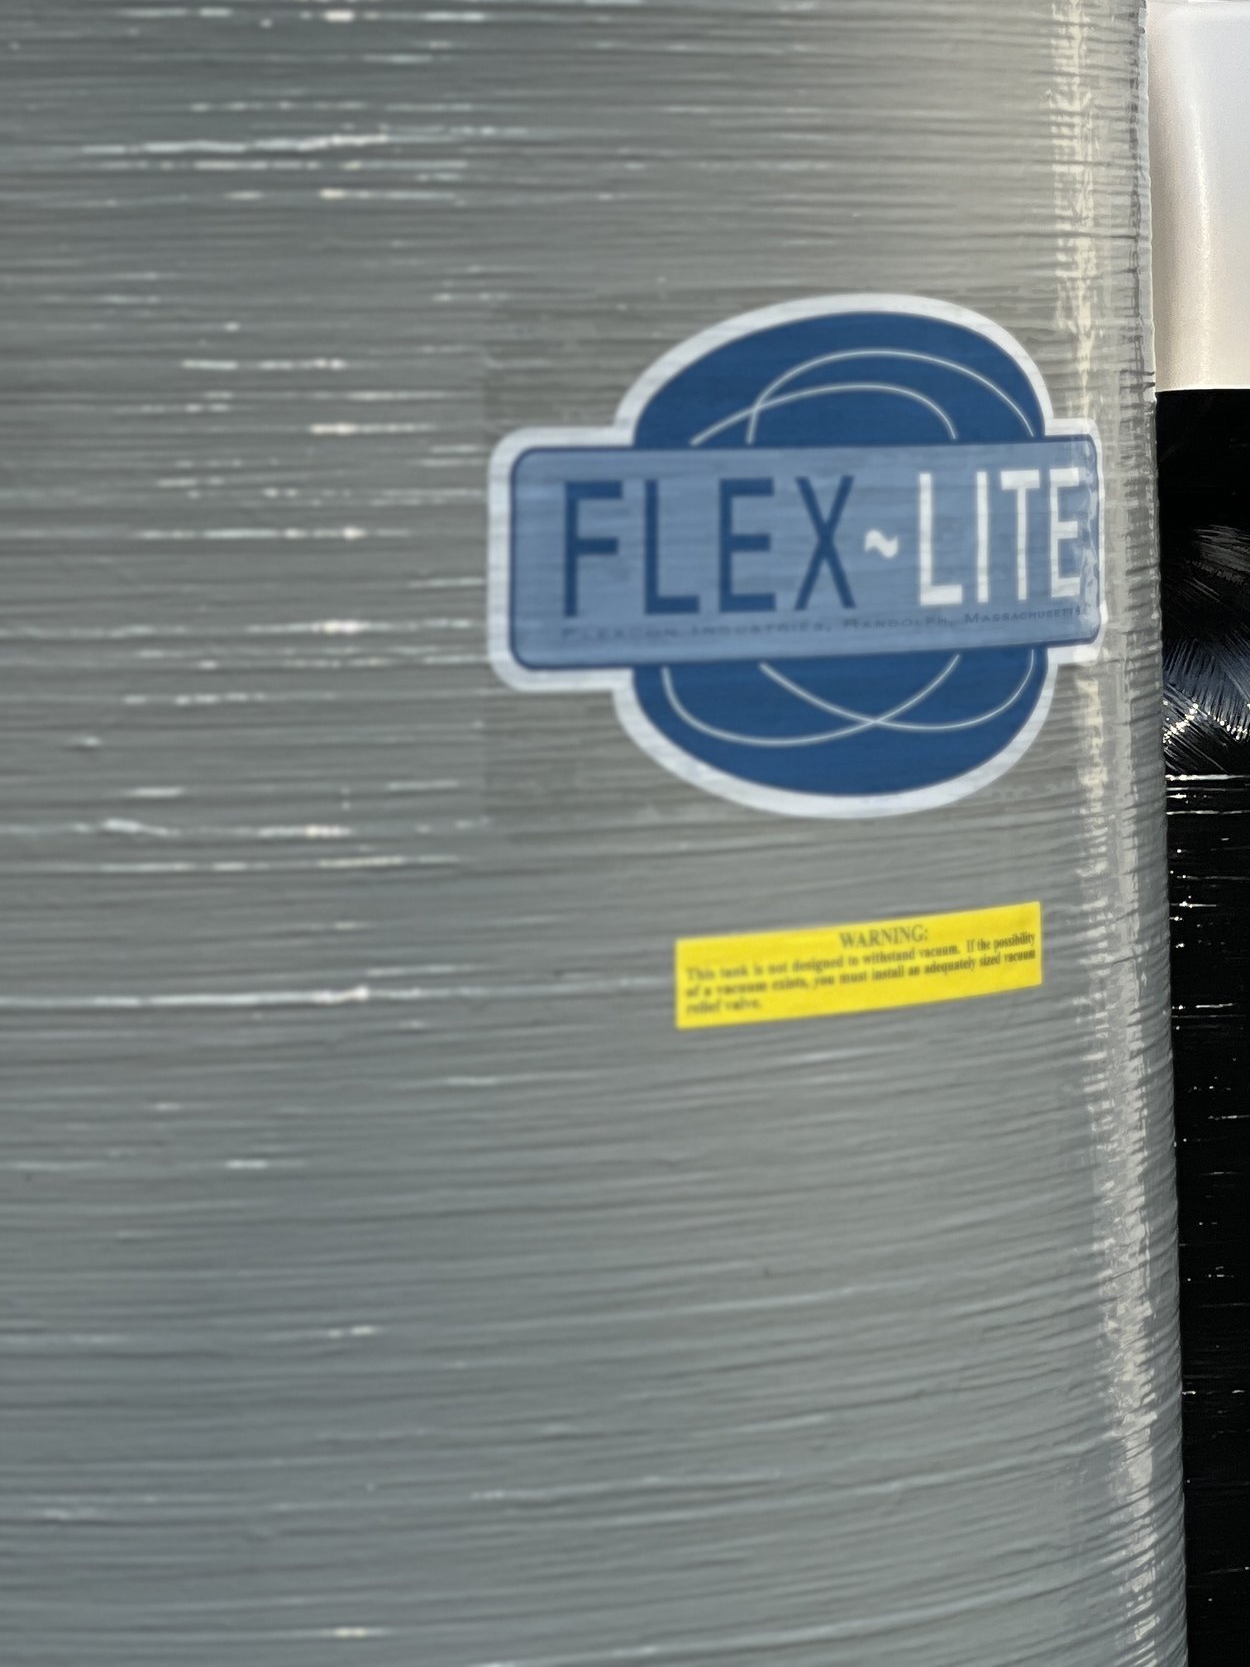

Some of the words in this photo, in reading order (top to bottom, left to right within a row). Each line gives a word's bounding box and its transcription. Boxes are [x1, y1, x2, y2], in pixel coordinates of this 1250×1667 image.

[839, 924, 929, 948] WARNING:
[685, 985, 700, 997] of
[704, 987, 712, 996] a
[717, 981, 767, 995] vacuum
[772, 977, 809, 991] exists,
[813, 976, 835, 991] you
[839, 971, 867, 984] must
[871, 965, 904, 981] install
[907, 965, 920, 976] an
[924, 956, 976, 976] adequately
[979, 952, 1001, 967] sized
[1003, 949, 1036, 963] vacuum
[686, 966, 715, 981] This
[721, 965, 748, 979] tank
[754, 964, 764, 975] is
[768, 962, 788, 974] not
[792, 955, 844, 973] designed
[848, 955, 859, 965] to
[862, 948, 915, 965] withstand
[918, 943, 961, 957] vacuum.
[966, 938, 975, 953] If
[977, 937, 991, 951] the
[993, 931, 1036, 952] possibility
[685, 999, 721, 1014] relief
